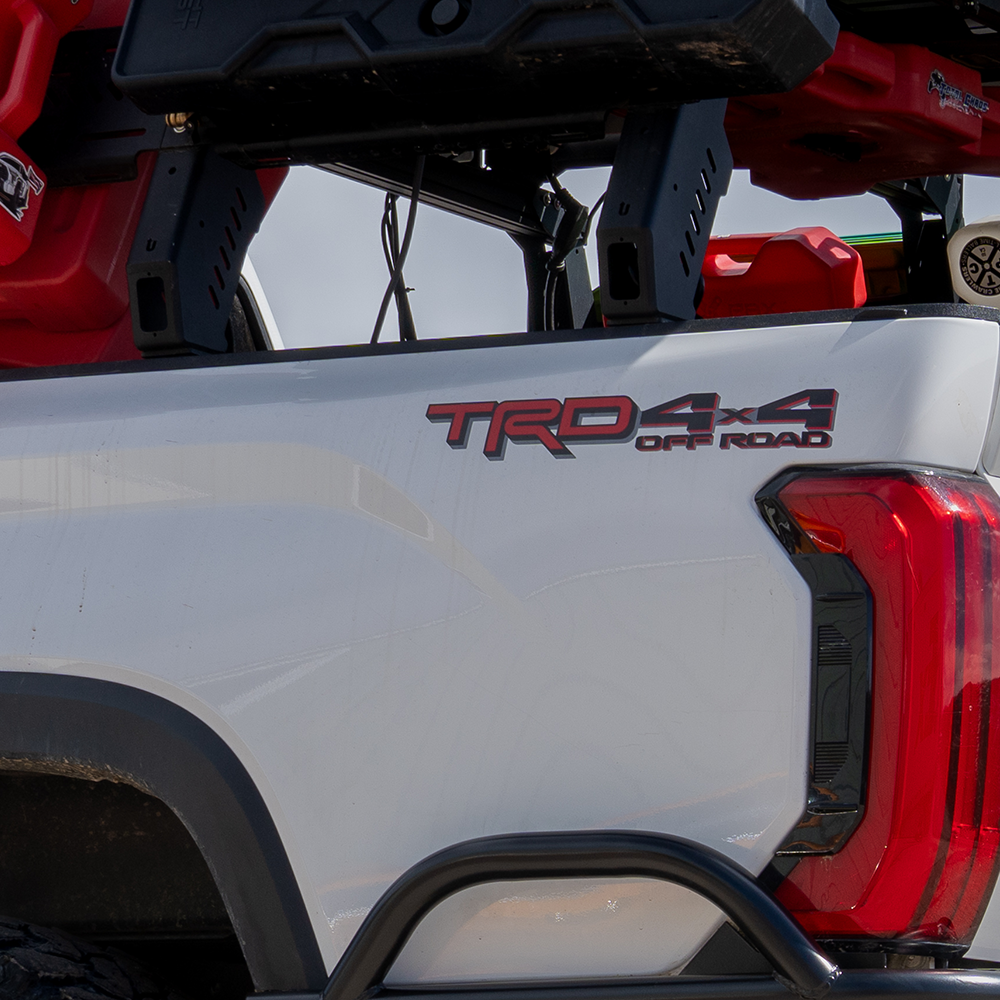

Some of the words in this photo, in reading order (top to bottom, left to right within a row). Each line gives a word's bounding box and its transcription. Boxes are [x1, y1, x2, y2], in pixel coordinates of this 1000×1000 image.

[425, 394, 642, 462] TRD
[635, 431, 716, 452] OFF
[719, 430, 833, 451] ROAD
